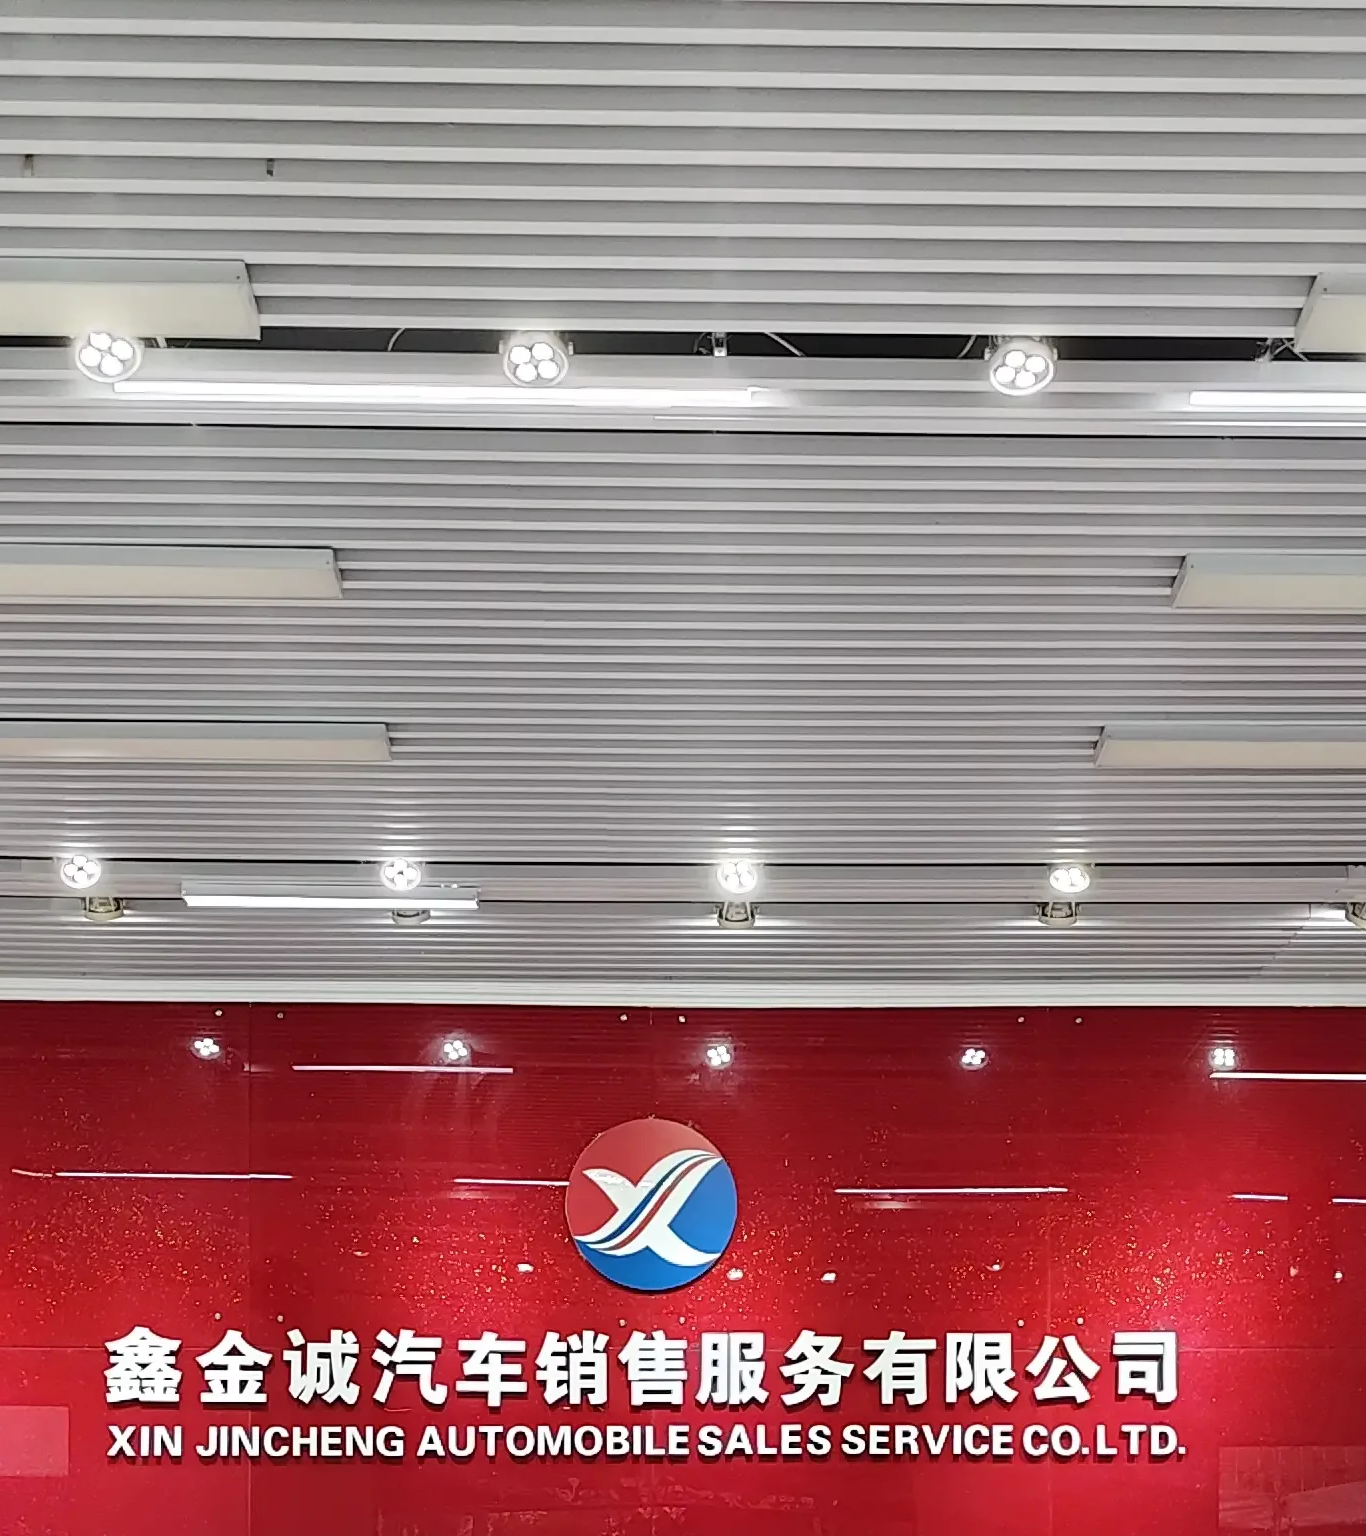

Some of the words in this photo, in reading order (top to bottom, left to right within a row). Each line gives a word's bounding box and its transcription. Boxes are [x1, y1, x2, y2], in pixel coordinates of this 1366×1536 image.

[103, 1324, 1178, 1408] 鑫金诚汽车销售服务有限公司
[107, 1425, 182, 1458] XIN
[196, 1425, 405, 1458] JINCHENG
[417, 1424, 690, 1457] AUTOMOBILE
[697, 1424, 833, 1457] SALES
[841, 1424, 1014, 1456] SERVICE
